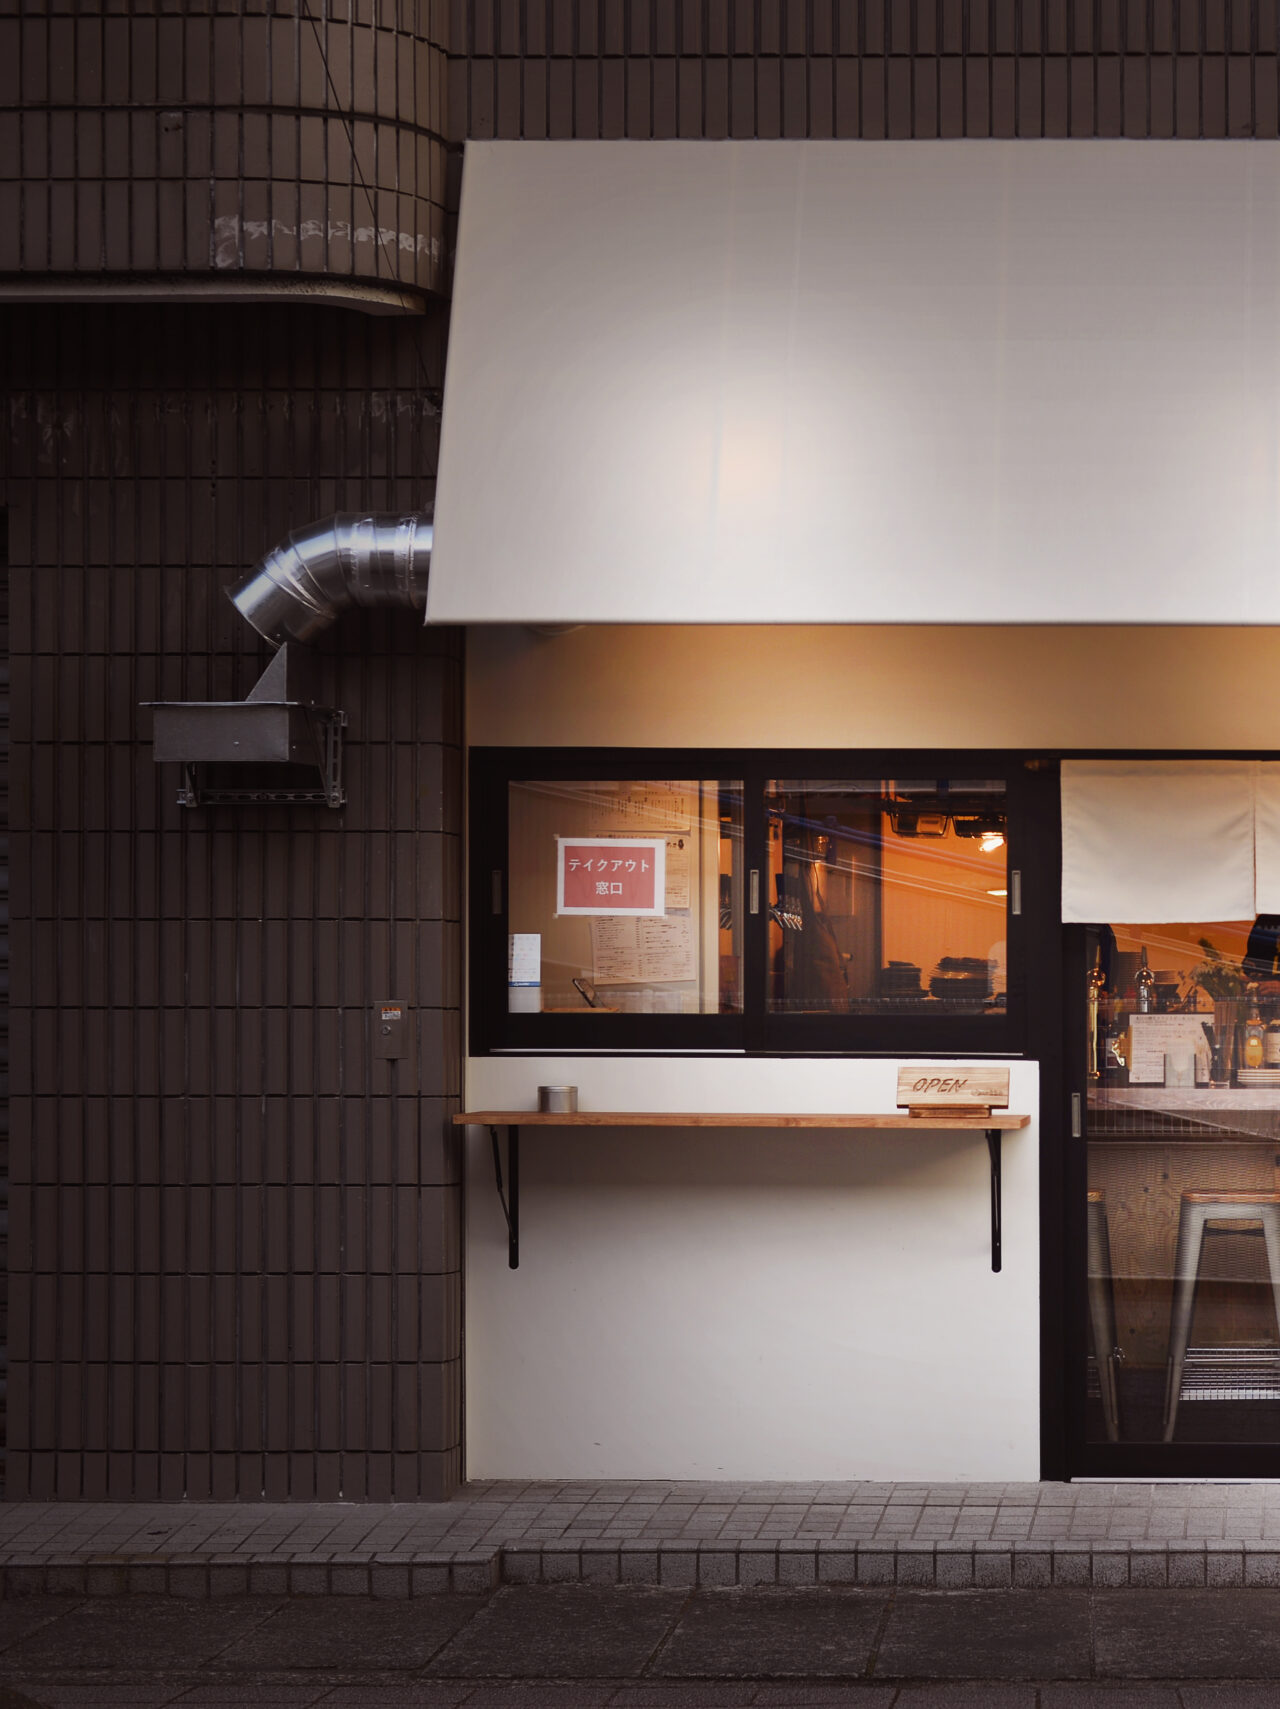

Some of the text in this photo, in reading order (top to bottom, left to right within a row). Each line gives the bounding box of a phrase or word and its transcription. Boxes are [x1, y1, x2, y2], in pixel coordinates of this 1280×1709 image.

[568, 859, 649, 872] テイクアウト
[595, 881, 623, 895] 窓口
[912, 1078, 968, 1093] OPEN
